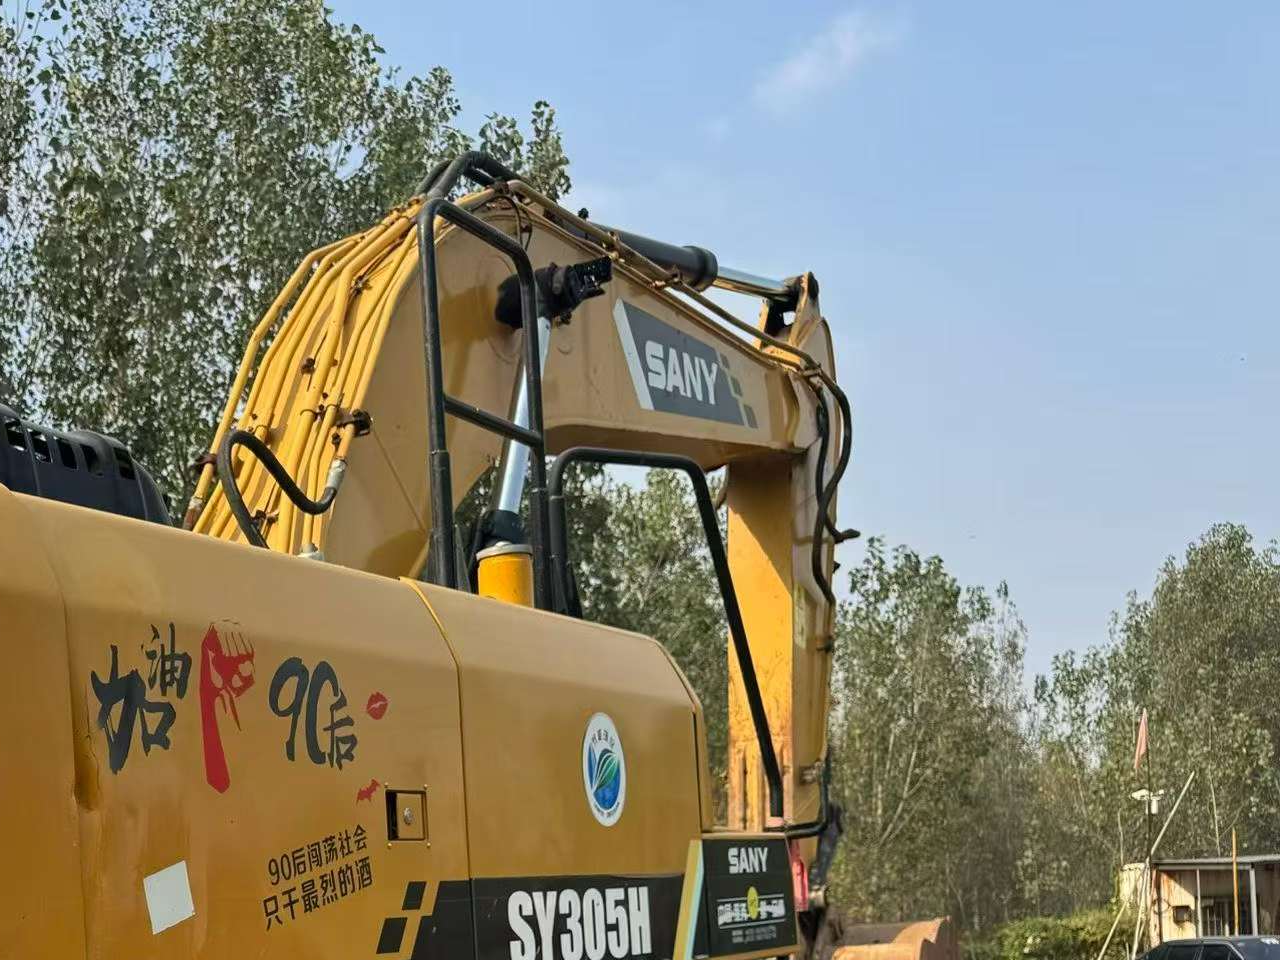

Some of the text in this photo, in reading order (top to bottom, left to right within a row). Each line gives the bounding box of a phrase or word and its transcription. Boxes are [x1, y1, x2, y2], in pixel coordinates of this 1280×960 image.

[644, 339, 719, 405] SANY
[90, 622, 192, 775] 加油
[268, 656, 358, 770] 90后
[268, 824, 369, 885] 90后闯荡社会
[728, 847, 768, 874] SANY
[263, 856, 374, 931] 只干最烈的酒
